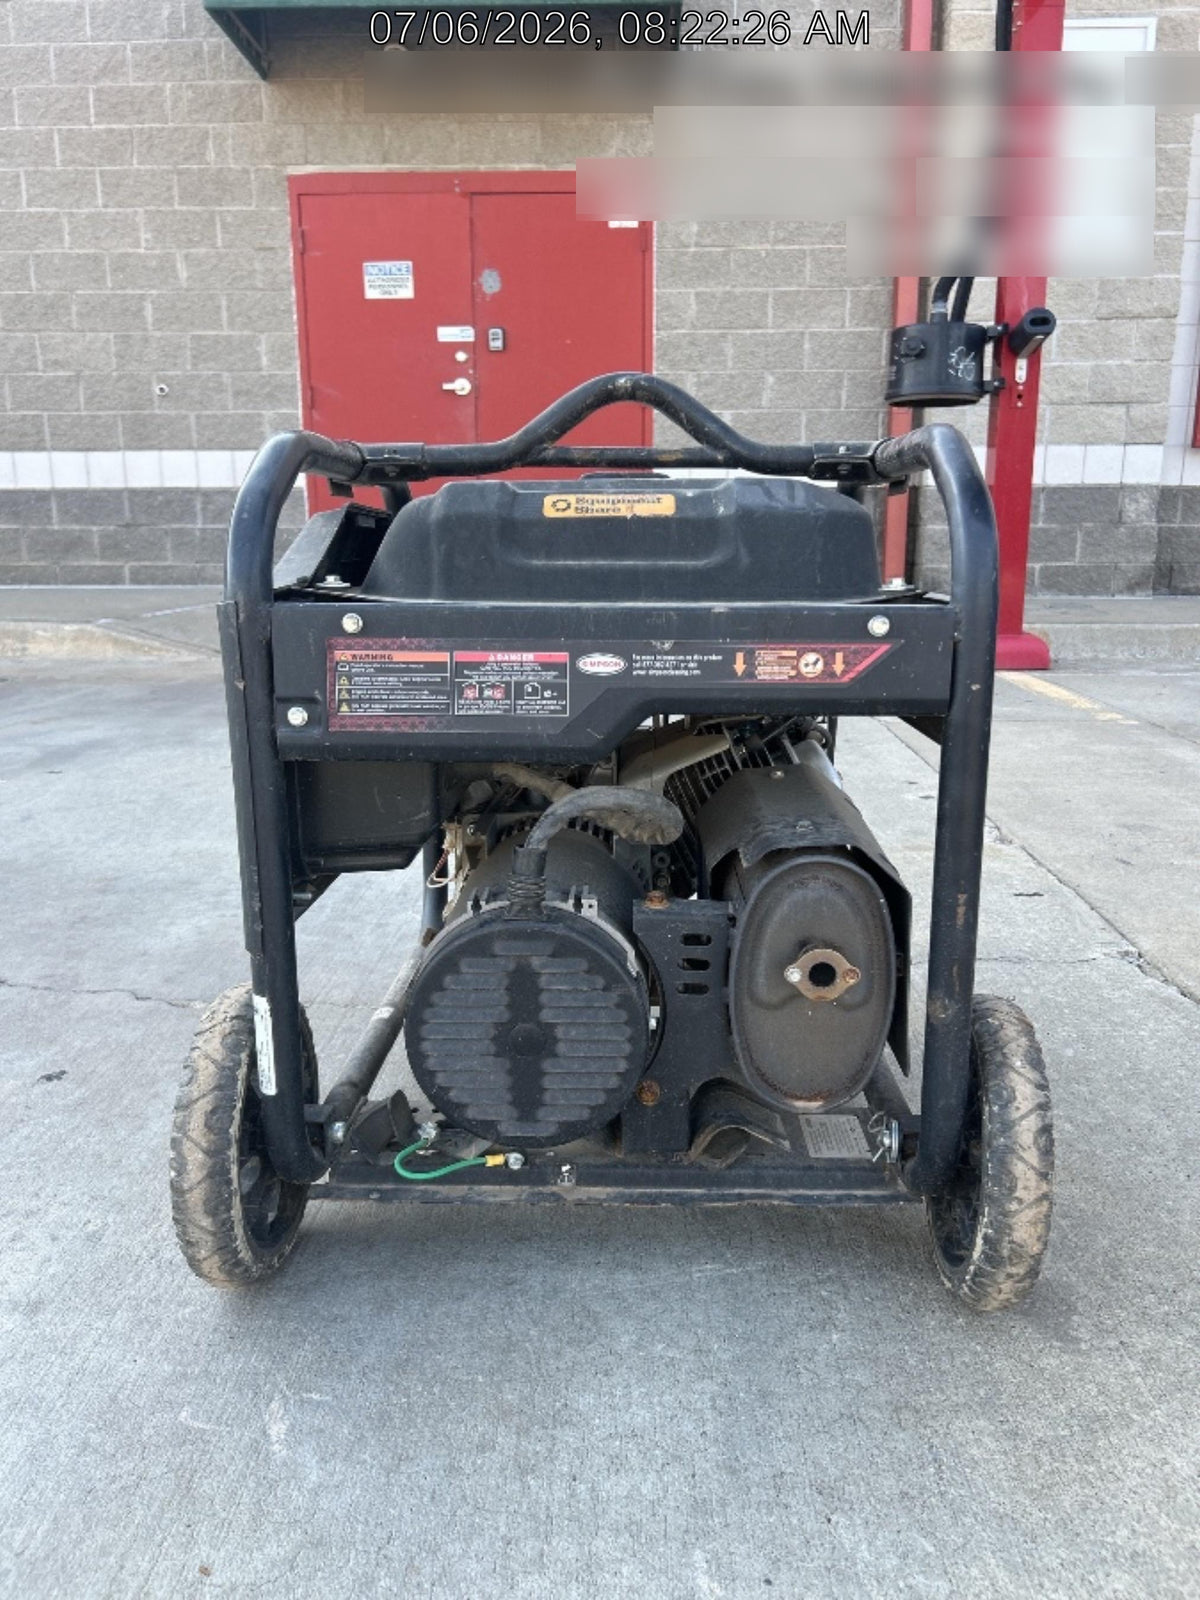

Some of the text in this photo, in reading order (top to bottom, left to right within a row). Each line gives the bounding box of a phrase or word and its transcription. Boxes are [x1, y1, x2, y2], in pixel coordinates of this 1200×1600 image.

[365, 264, 410, 276] NOTICE
[350, 653, 394, 661] WARNING
[496, 653, 535, 662] DANGER
[581, 659, 622, 668] SIMPSON
